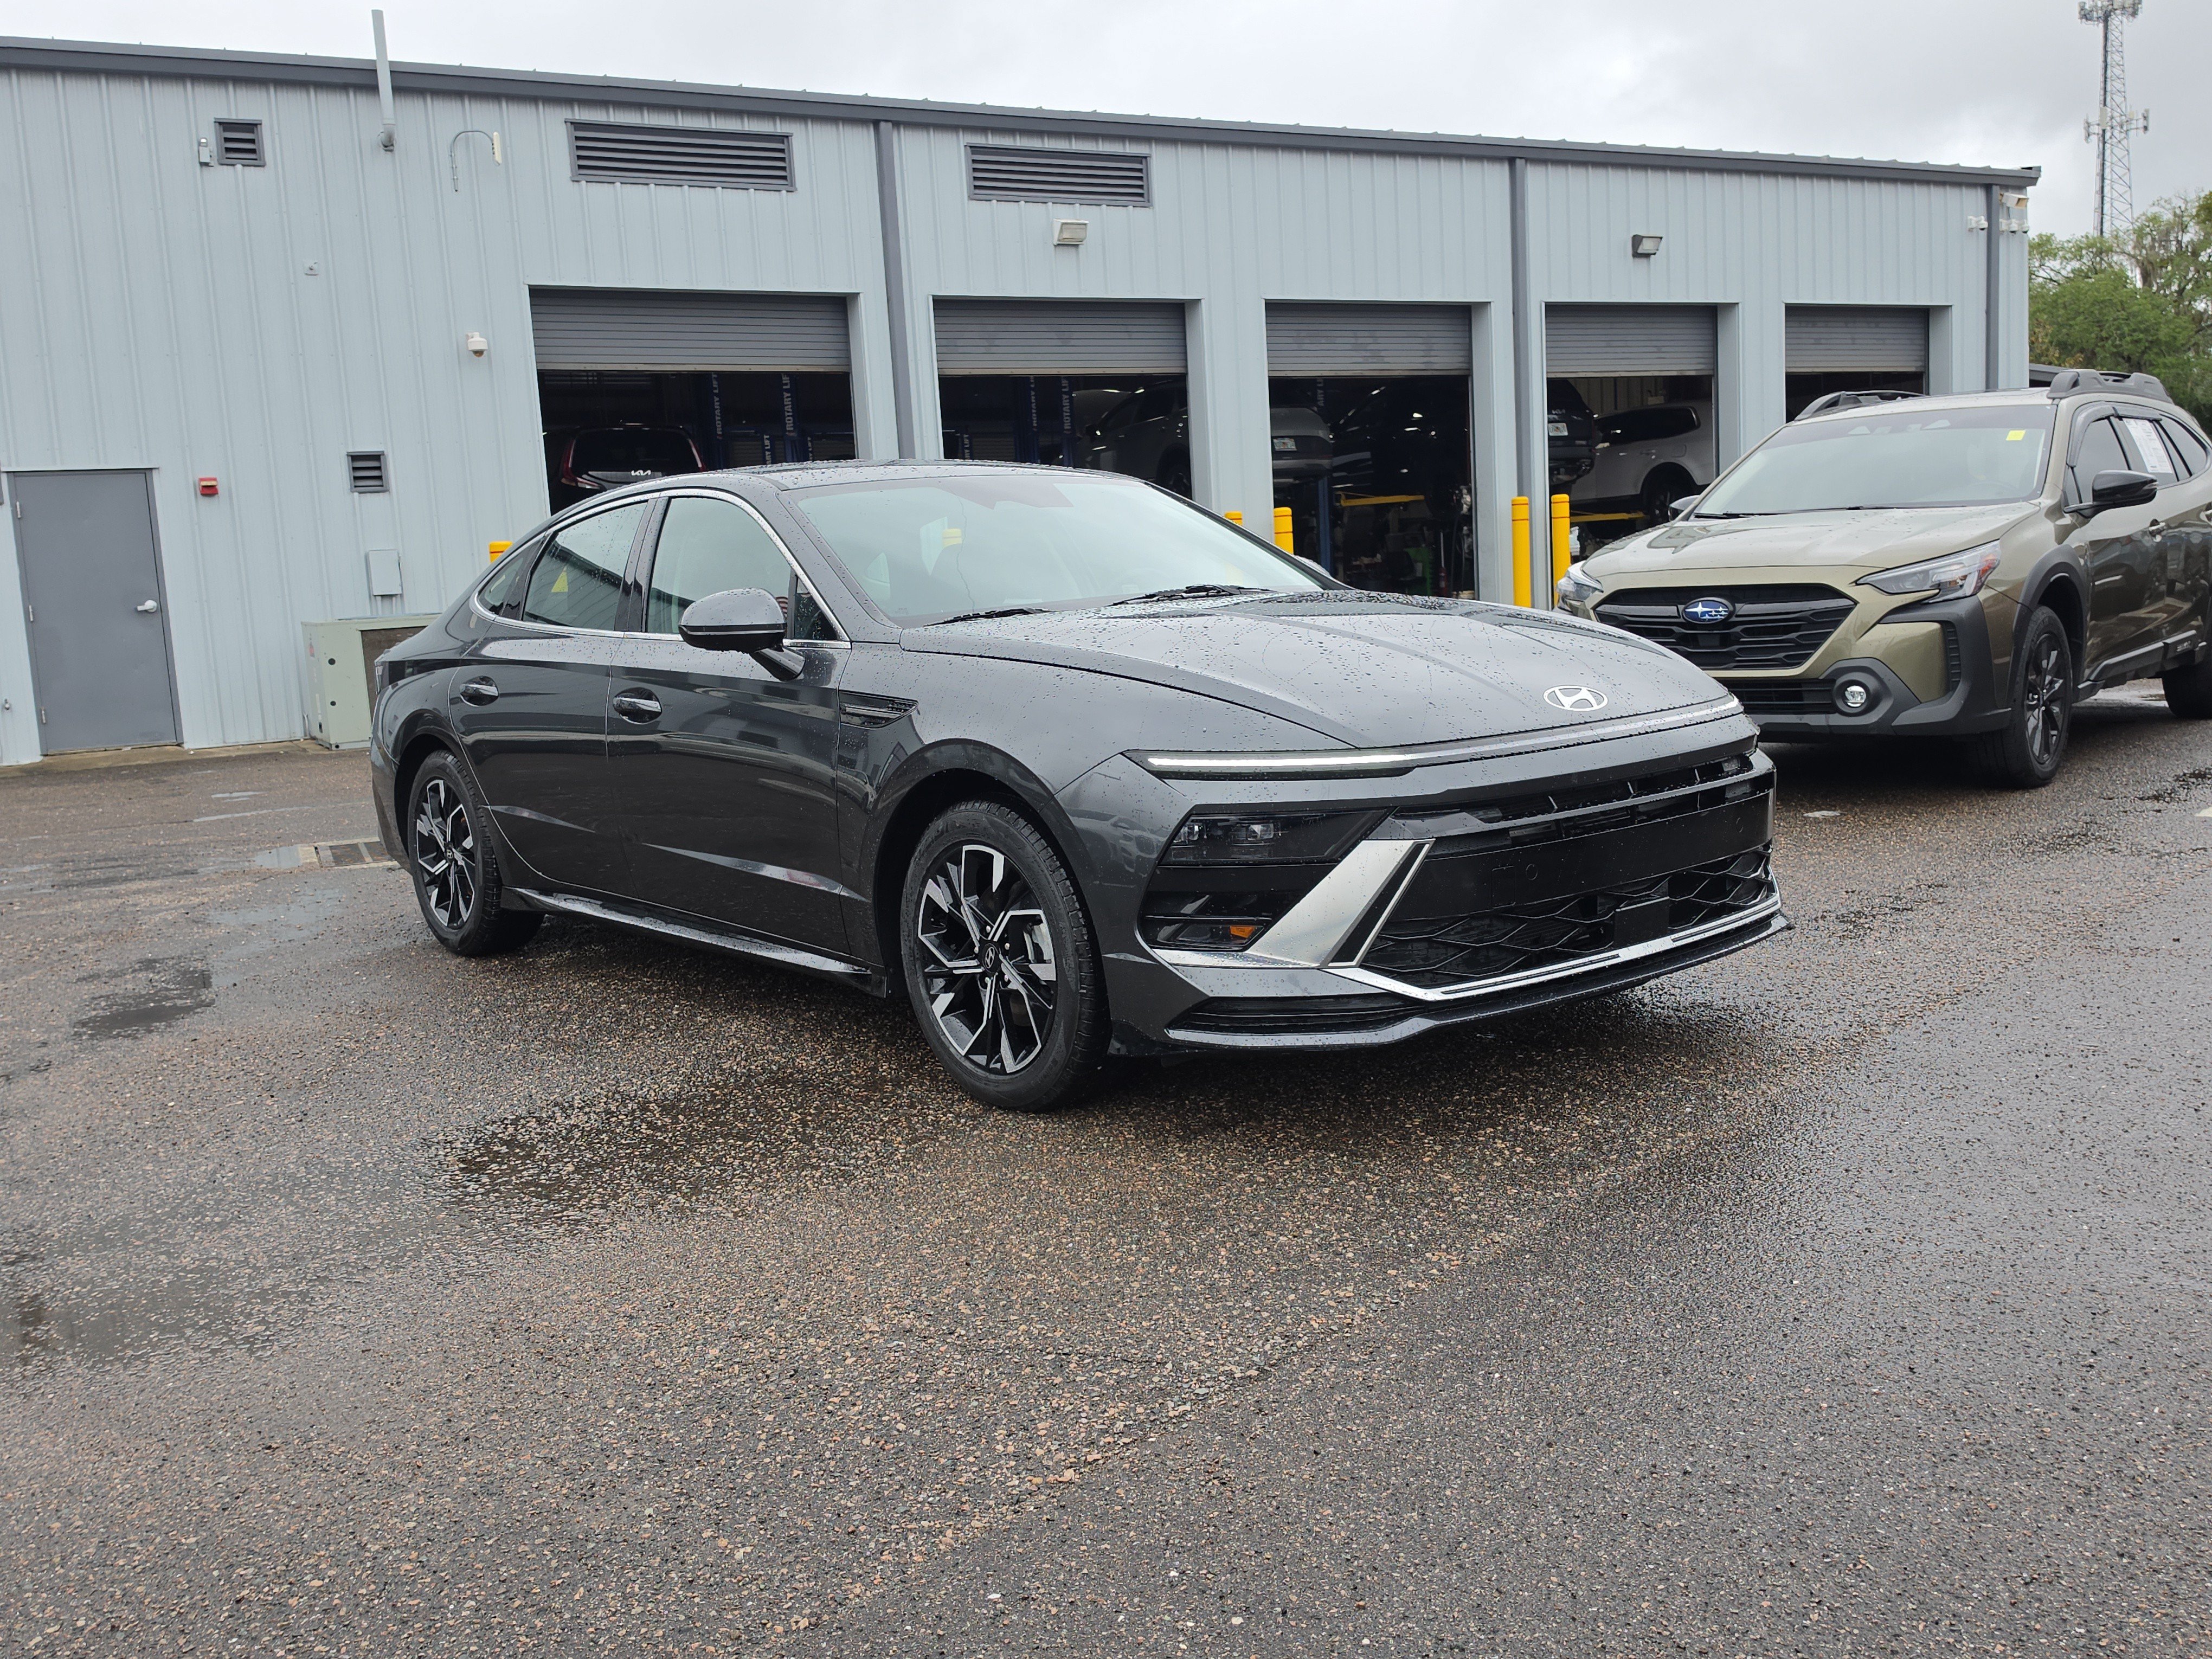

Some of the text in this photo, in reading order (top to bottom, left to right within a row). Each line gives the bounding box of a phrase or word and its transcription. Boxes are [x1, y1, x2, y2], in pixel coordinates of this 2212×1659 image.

[714, 396, 722, 434] ROTARY
[781, 372, 794, 430] ROTARY LIF
[1061, 378, 1071, 429] ROTARY LIF
[1316, 389, 1324, 406] ARY
